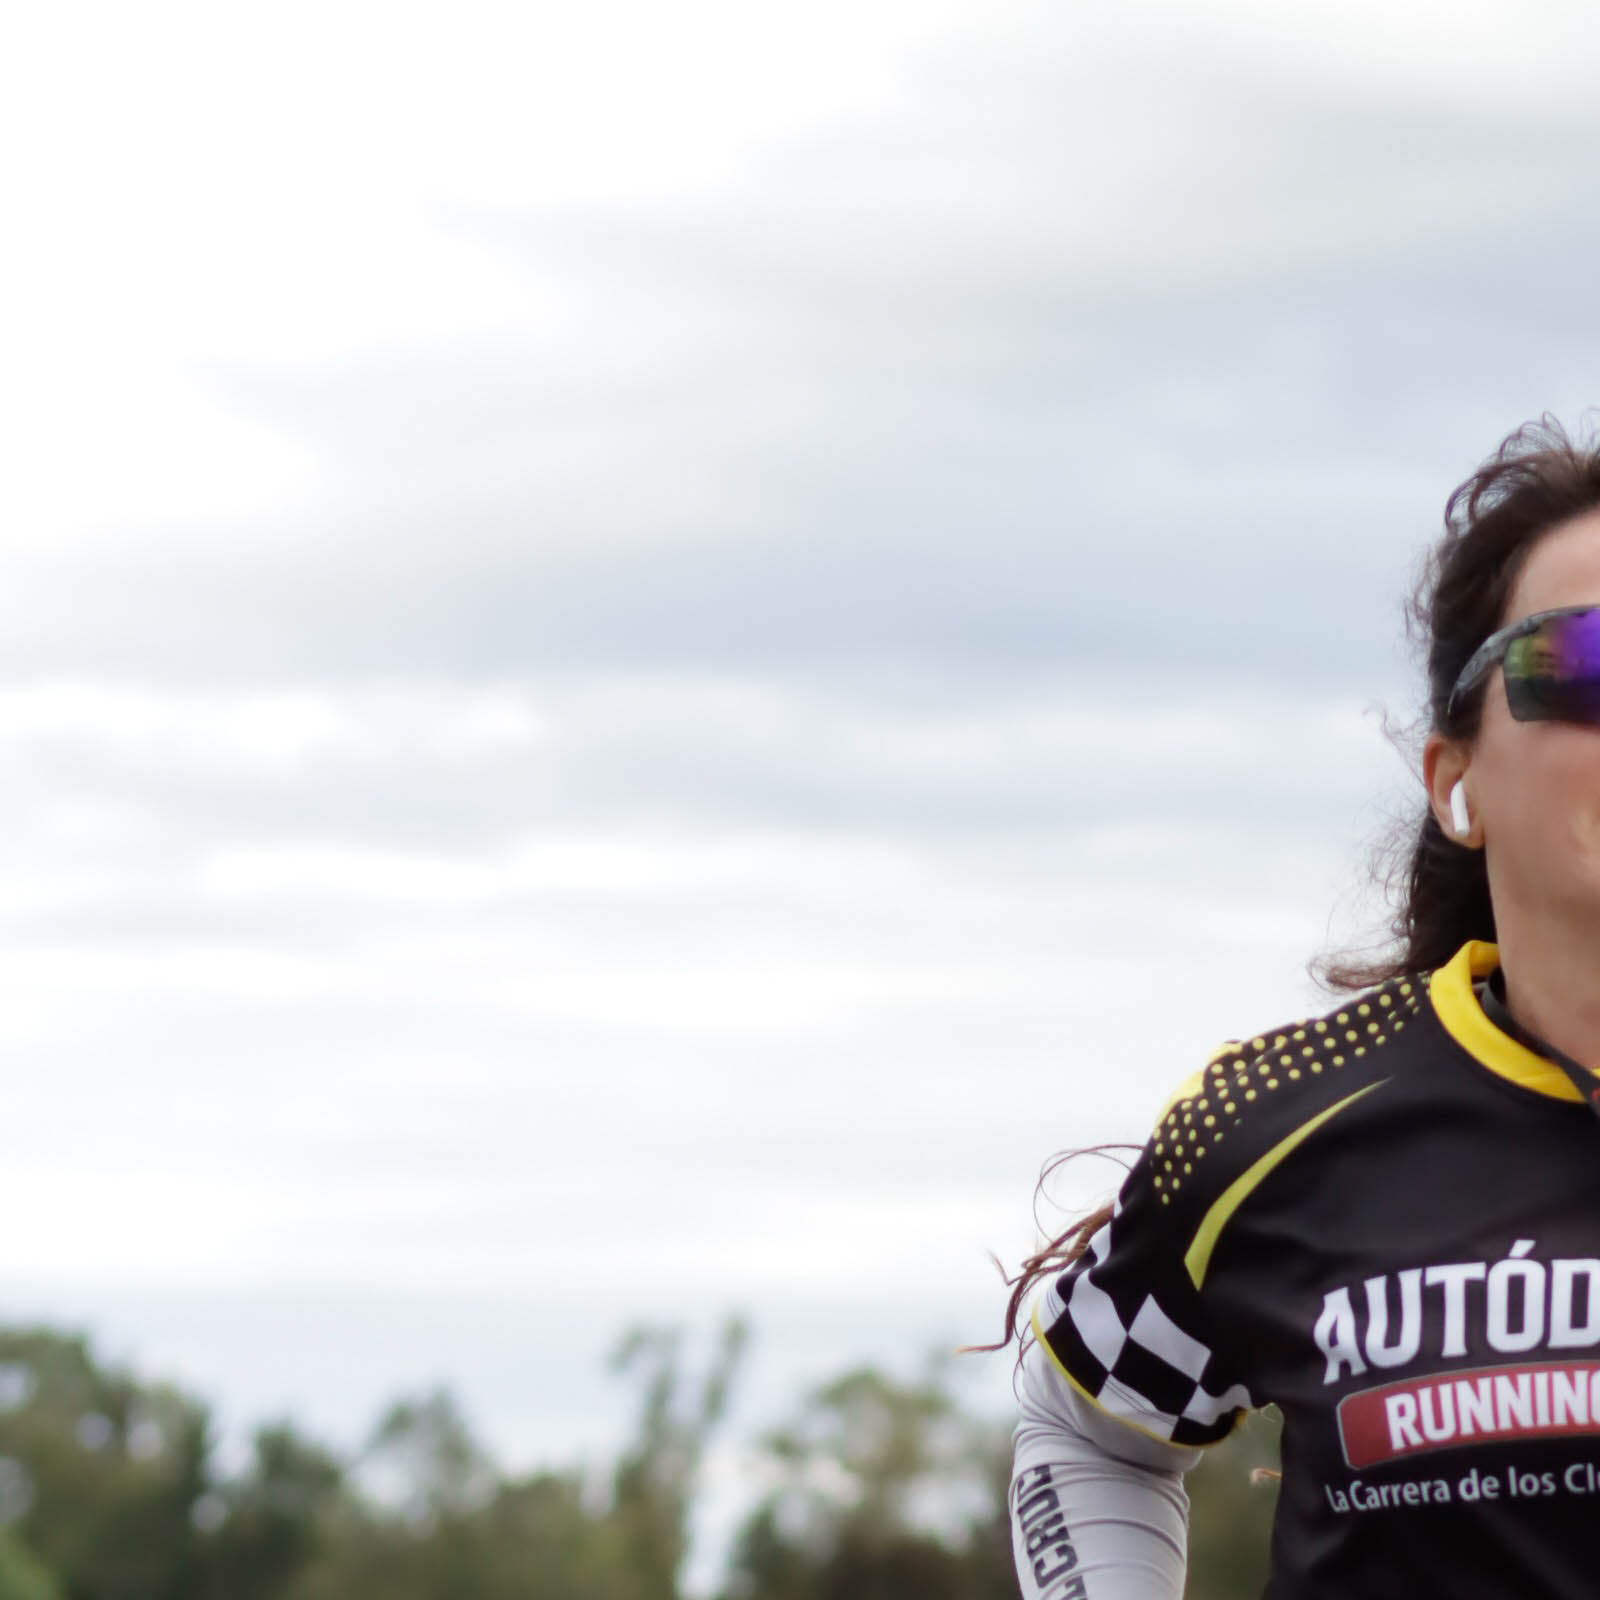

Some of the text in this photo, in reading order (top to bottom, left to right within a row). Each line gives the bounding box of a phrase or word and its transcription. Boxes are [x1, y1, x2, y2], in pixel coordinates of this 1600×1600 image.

[1350, 1479, 1451, 1511] Carrera
[1458, 1467, 1501, 1502] de
[1507, 1464, 1557, 1497] los
